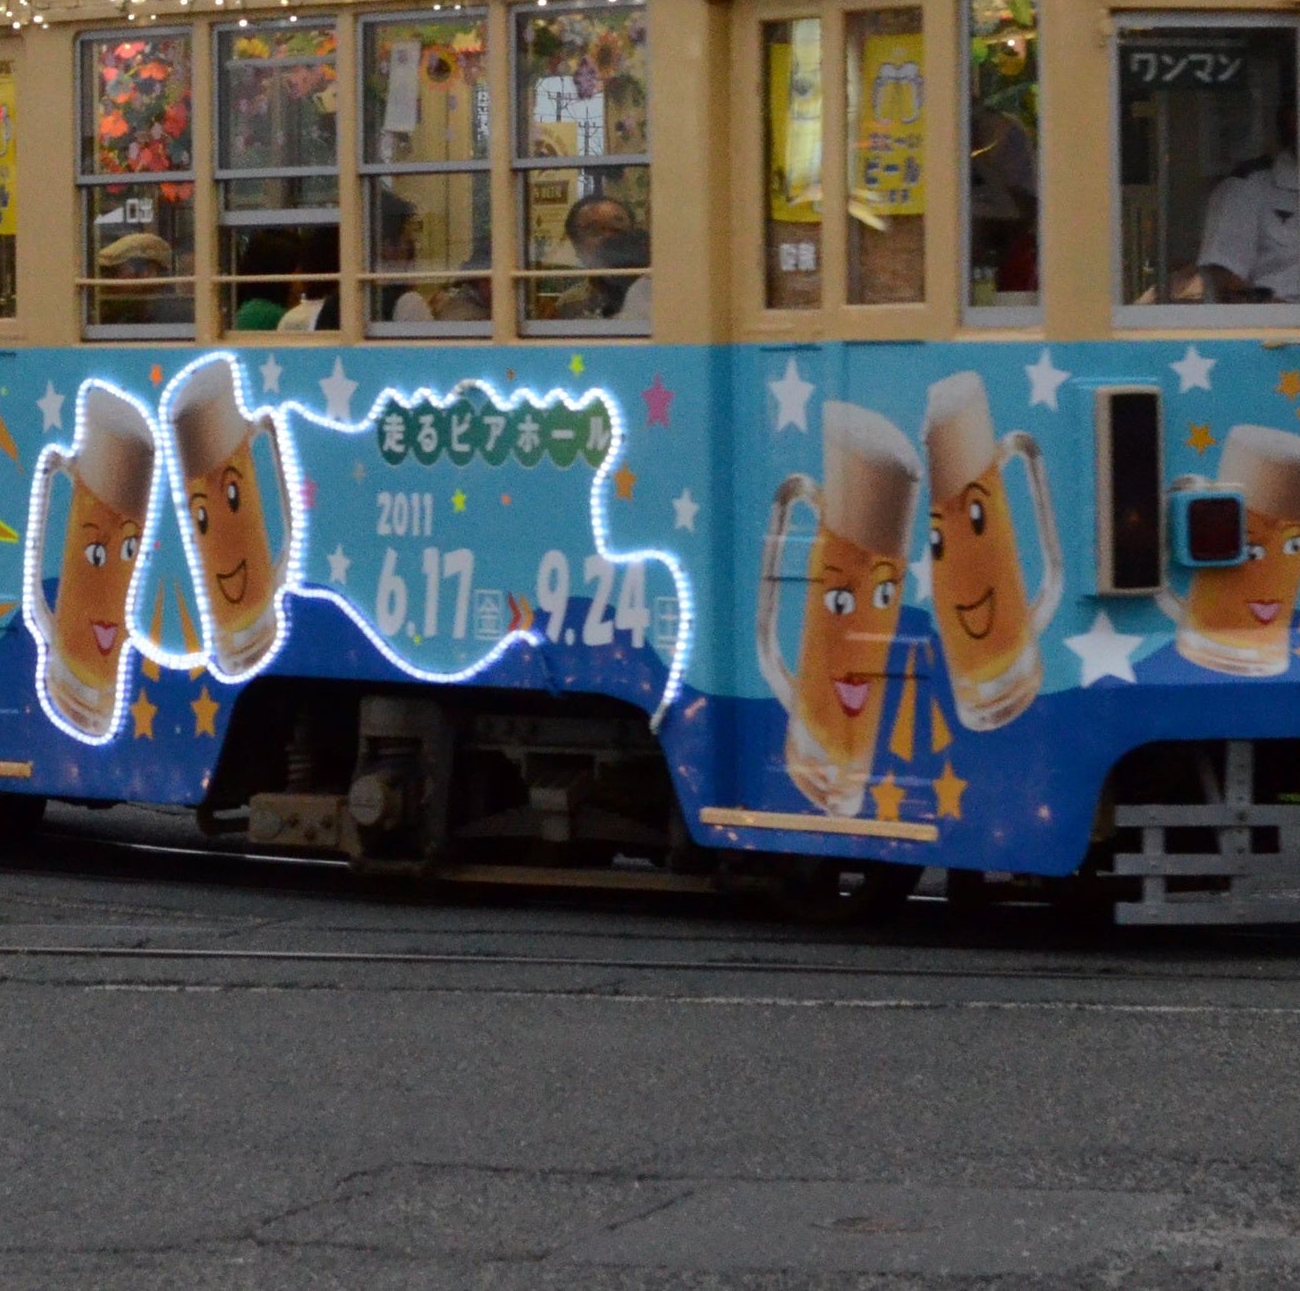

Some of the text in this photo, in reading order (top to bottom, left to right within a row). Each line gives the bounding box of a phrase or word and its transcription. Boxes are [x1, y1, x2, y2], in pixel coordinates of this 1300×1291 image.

[1129, 52, 1242, 83] ワンマン
[382, 414, 611, 454] 走るビアホール
[376, 491, 433, 537] 2011
